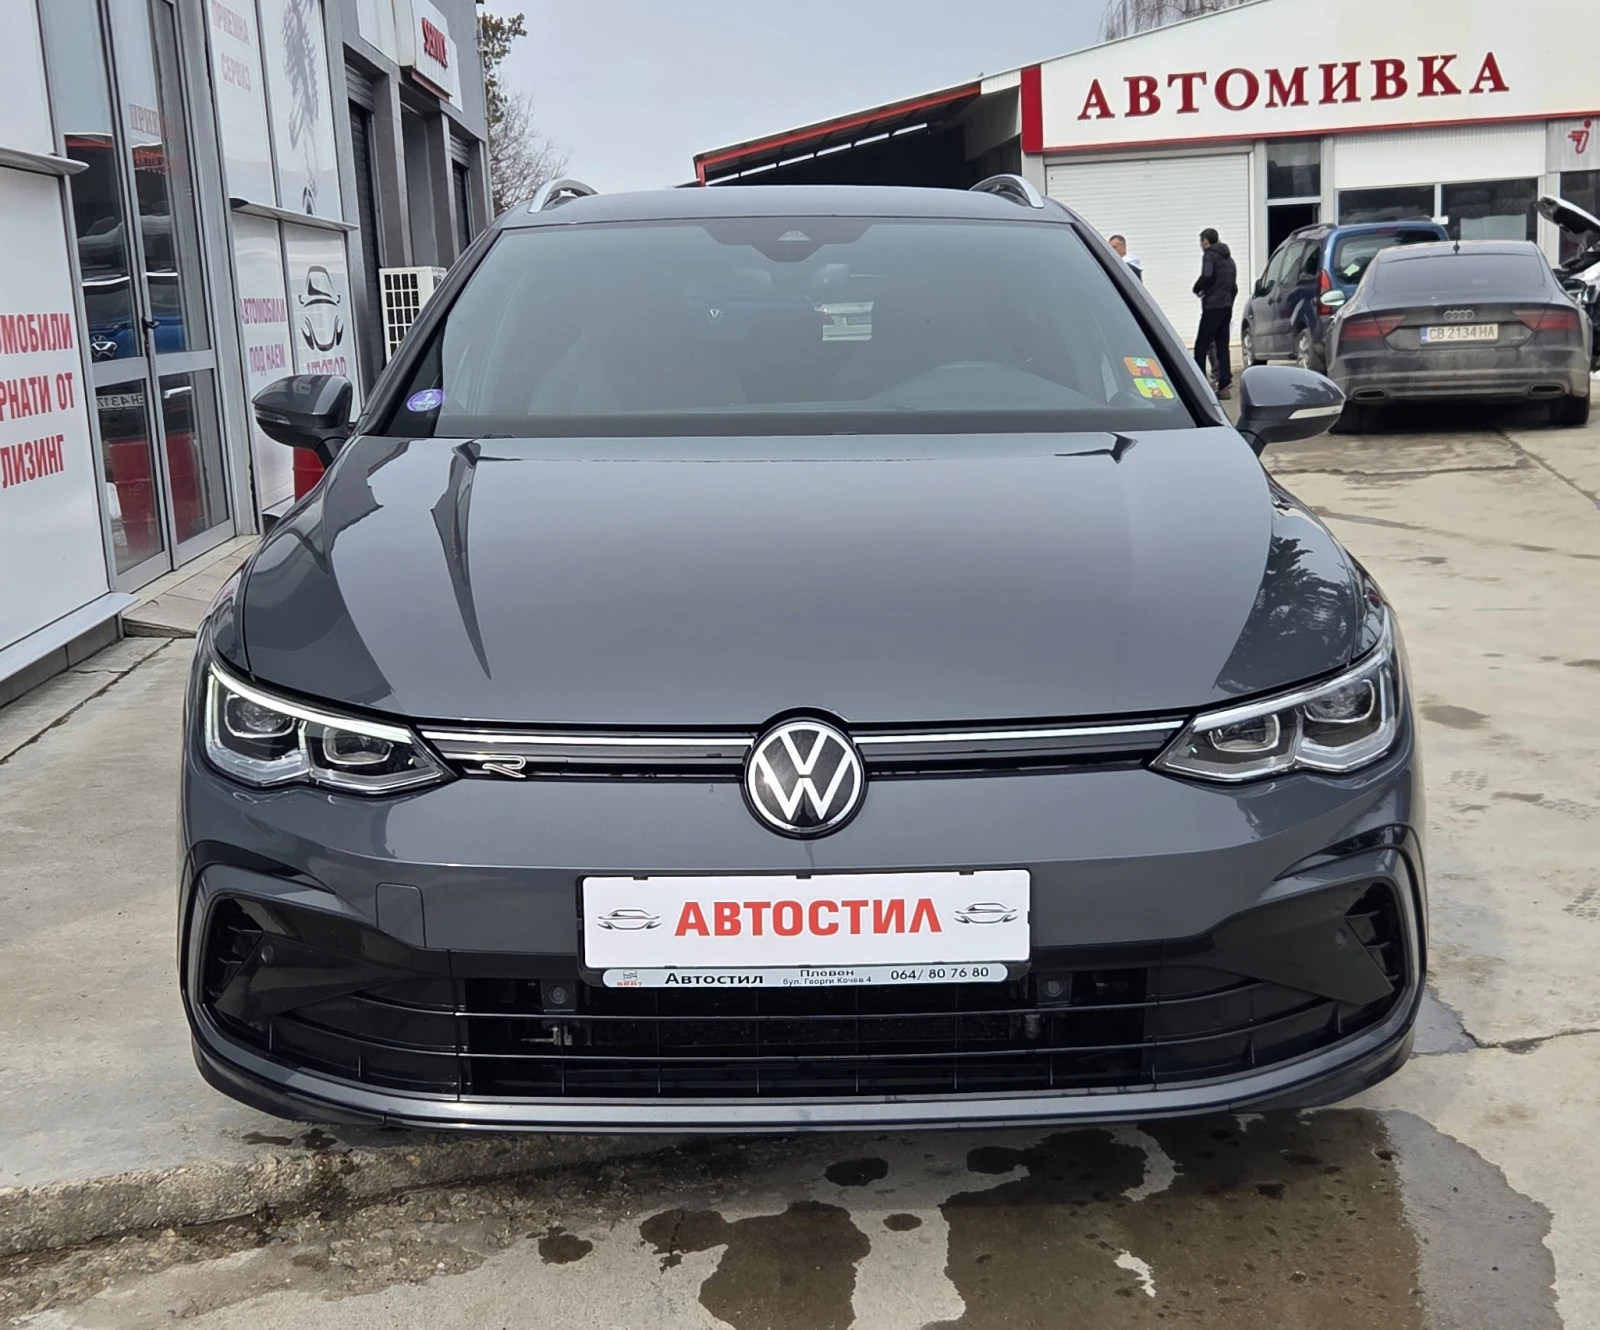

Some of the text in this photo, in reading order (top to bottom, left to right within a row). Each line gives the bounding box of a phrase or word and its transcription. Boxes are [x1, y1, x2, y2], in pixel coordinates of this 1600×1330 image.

[1077, 51, 1510, 121] АВТОМИВКА
[56, 372, 74, 411] ОТ
[1, 434, 64, 488] ЛИЗИНГ
[674, 898, 942, 937] АВТОСТИЛ
[664, 972, 764, 985] Автостил
[799, 969, 855, 977] Плевен
[890, 966, 990, 981] 064/ 80 76 80
